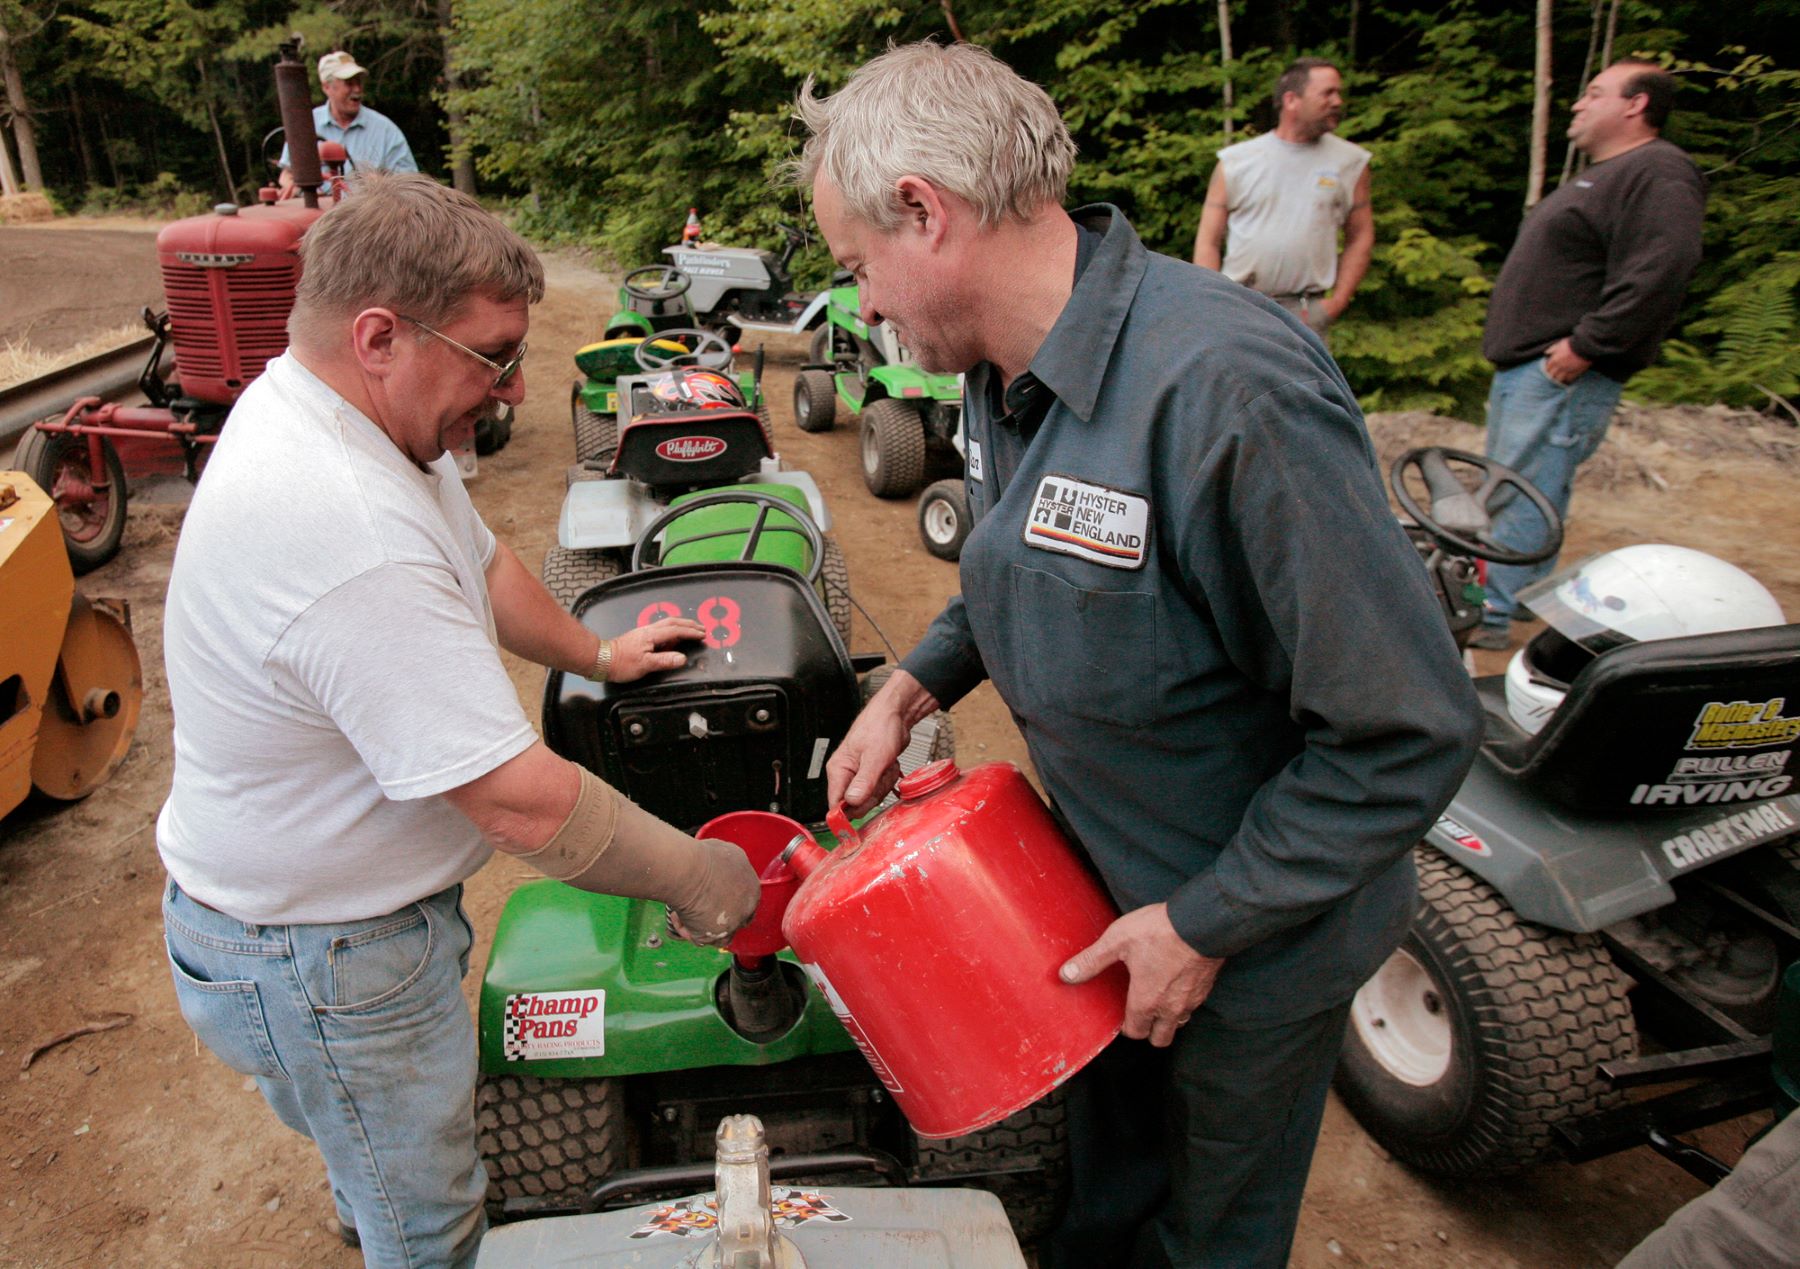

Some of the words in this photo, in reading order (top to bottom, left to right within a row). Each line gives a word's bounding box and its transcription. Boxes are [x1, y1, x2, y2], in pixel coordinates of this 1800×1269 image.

[1039, 499, 1074, 515] HYSTER
[1075, 506, 1105, 525] NEW
[1080, 491, 1127, 516] HYSTER
[1072, 521, 1141, 549] ENGLAND
[1675, 750, 1792, 774] PULLEN
[1630, 775, 1793, 804] IRVING
[511, 995, 599, 1019] Champ
[517, 1019, 578, 1040] Pans
